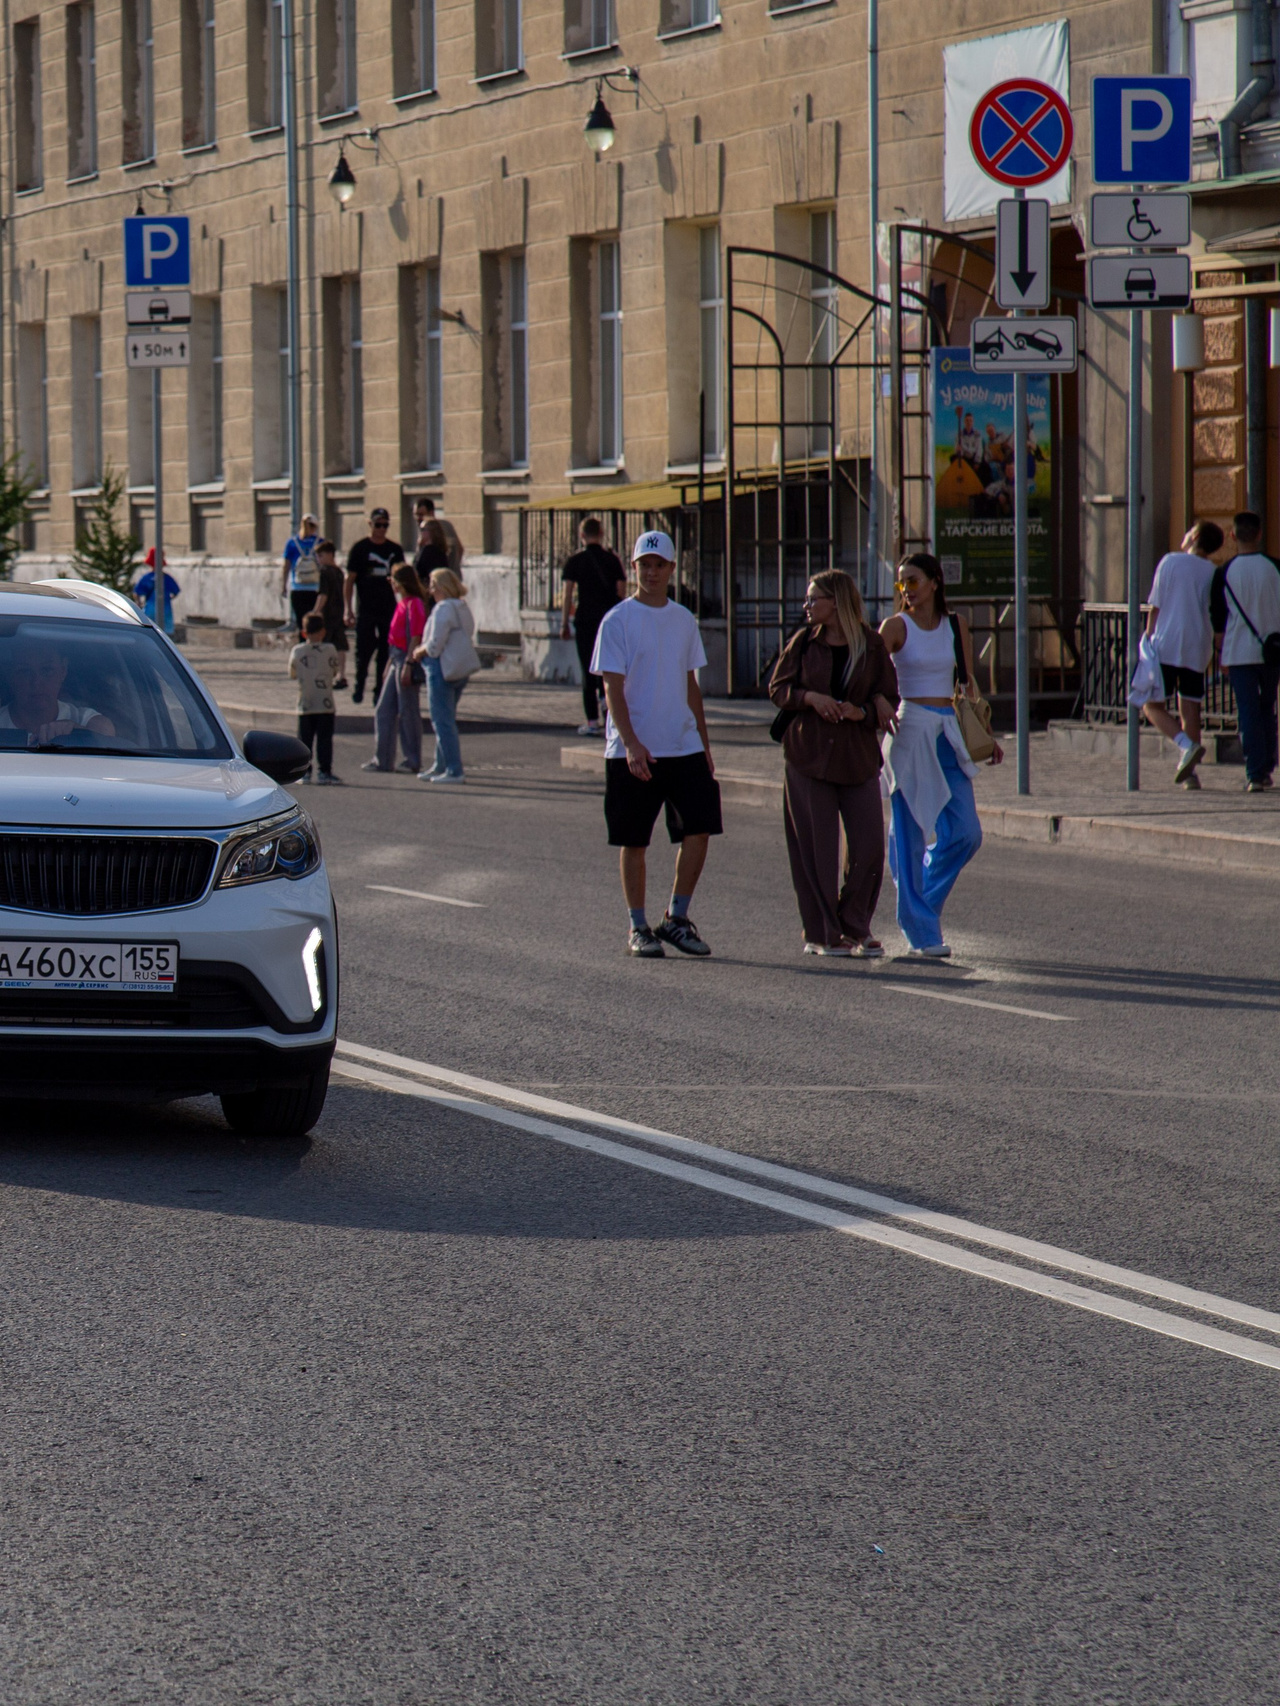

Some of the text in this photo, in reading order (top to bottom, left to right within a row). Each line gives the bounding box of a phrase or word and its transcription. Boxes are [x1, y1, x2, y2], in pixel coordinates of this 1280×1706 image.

[1121, 88, 1174, 172] P
[142, 223, 179, 279] P
[124, 947, 170, 971] 155
[134, 972, 157, 981] RUS
